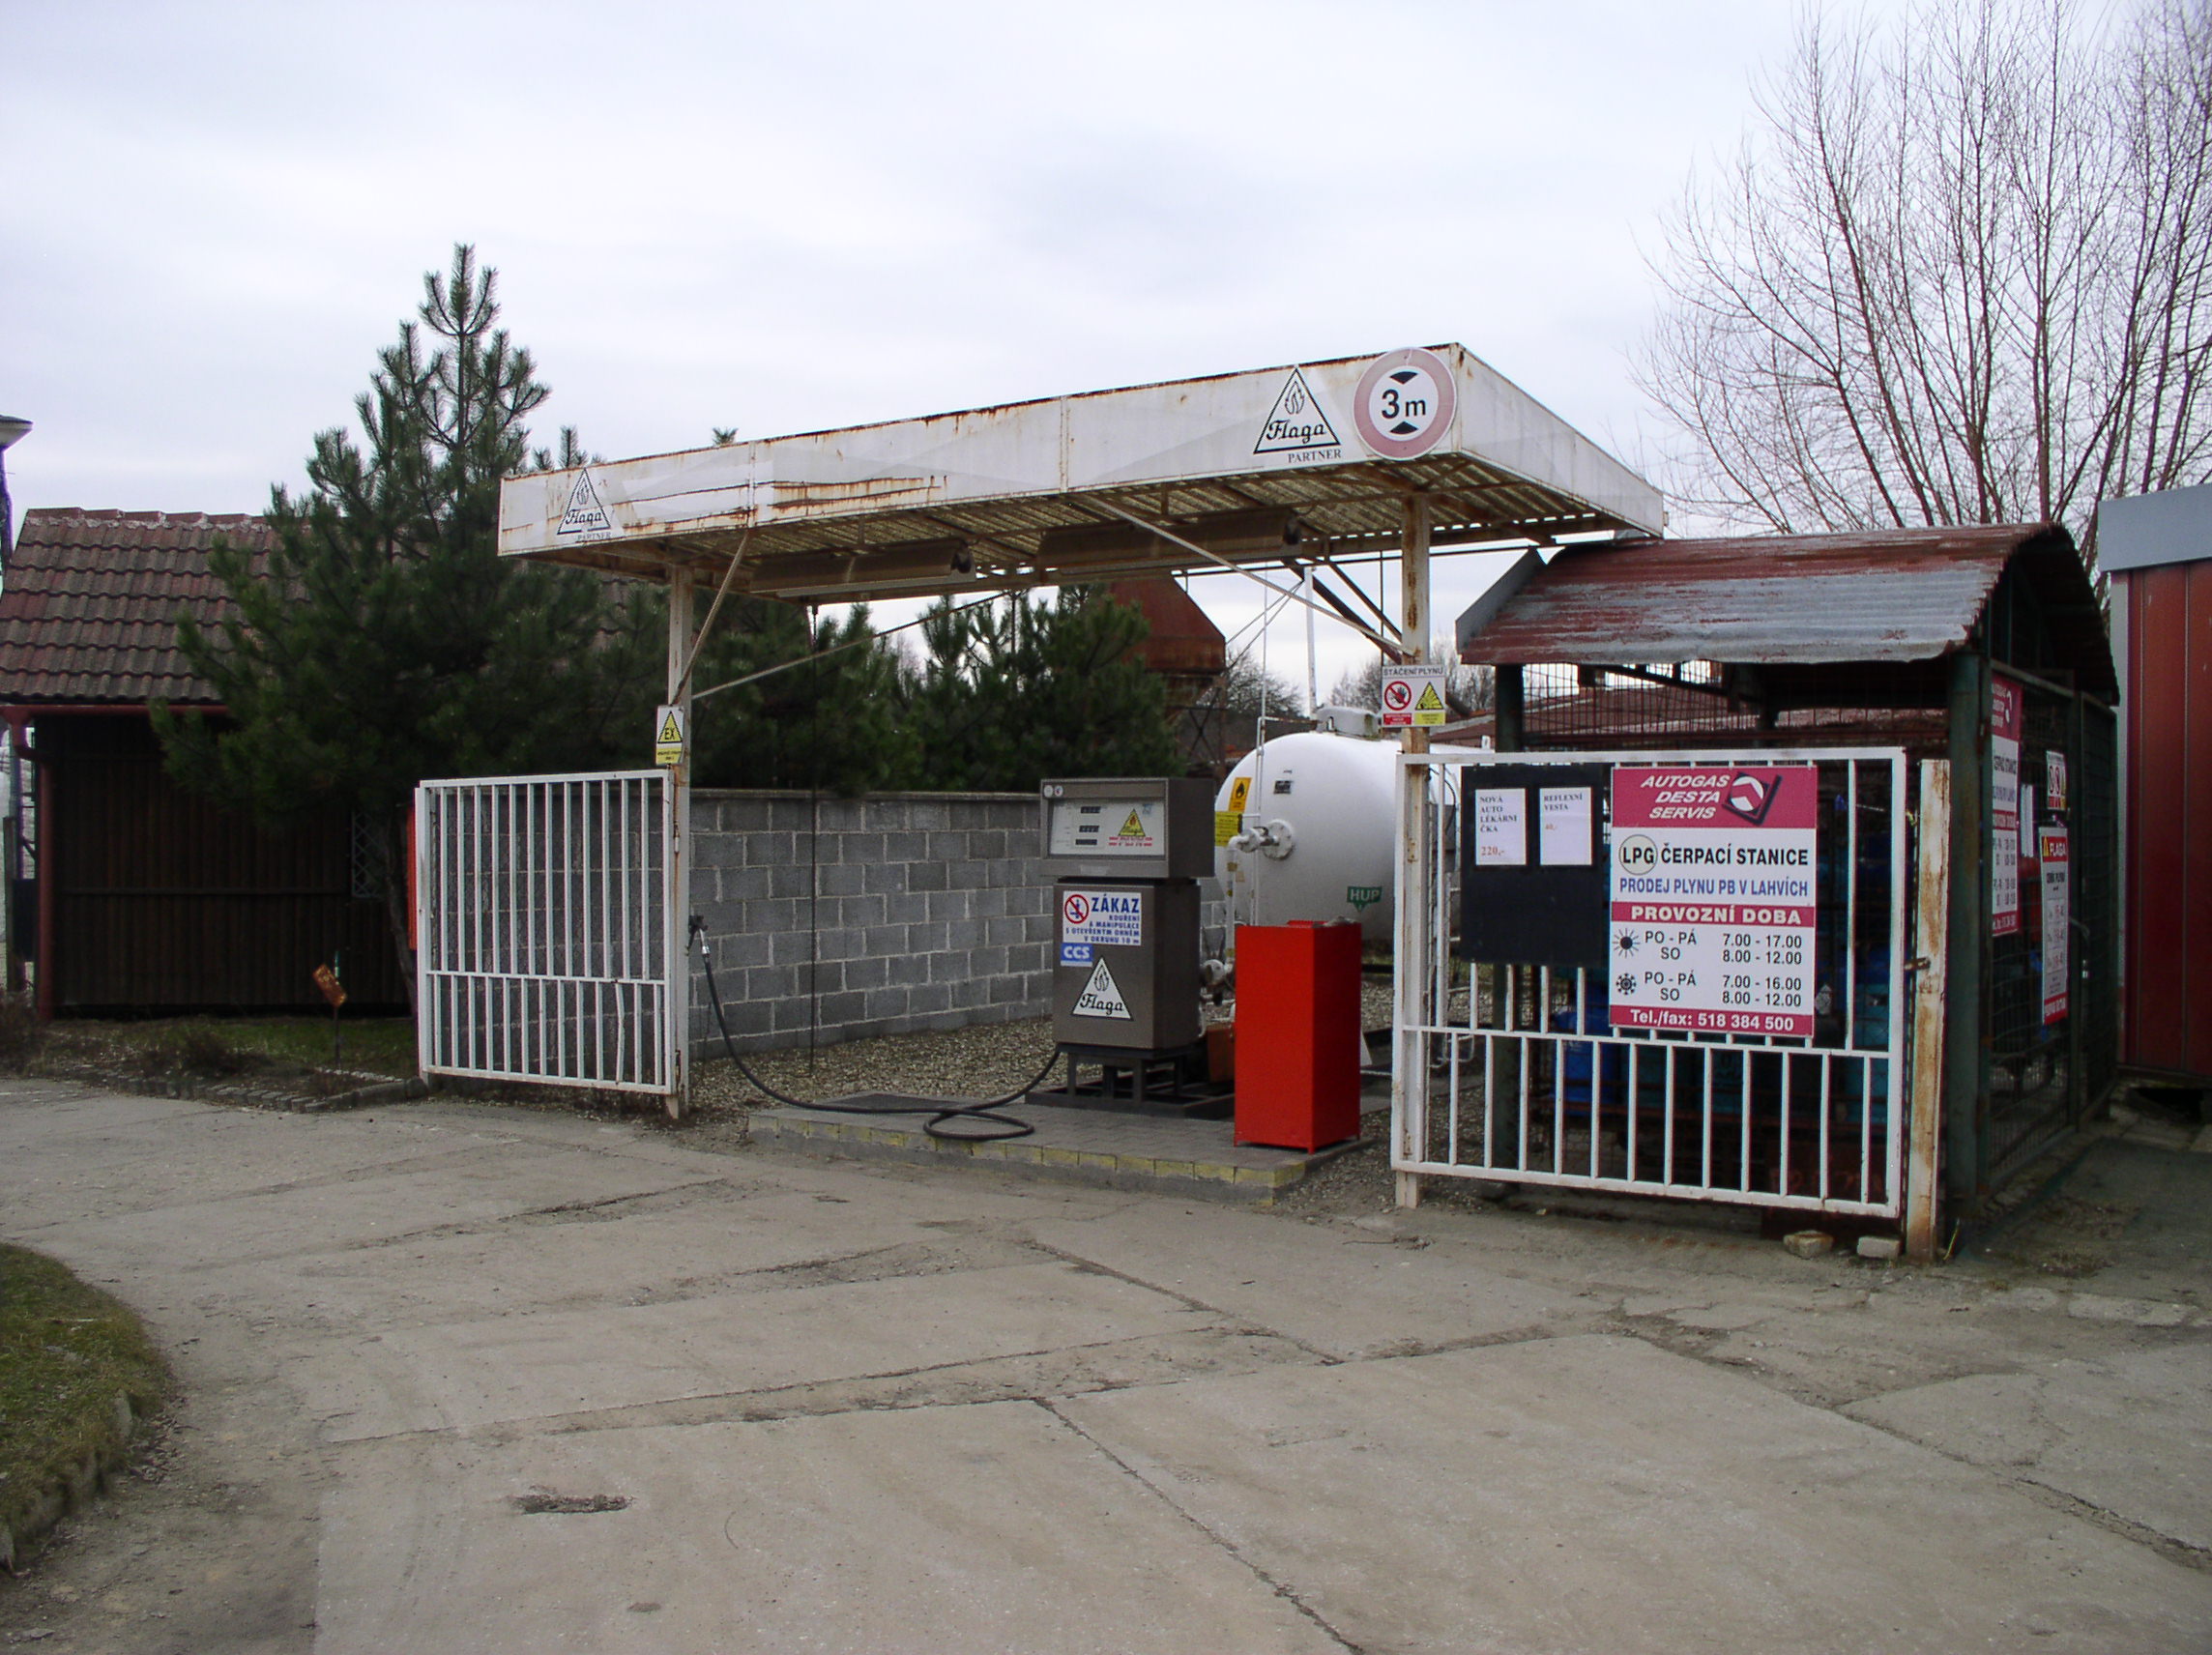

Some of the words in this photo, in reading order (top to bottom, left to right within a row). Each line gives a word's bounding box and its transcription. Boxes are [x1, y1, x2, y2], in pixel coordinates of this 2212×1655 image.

[1382, 389, 1400, 419] 3
[1406, 399, 1426, 418] m
[1266, 419, 1327, 444] Flaga
[1288, 449, 1342, 464] PARTNER
[565, 508, 601, 527] Flaga
[1418, 666, 1443, 675] PLYNU
[664, 727, 676, 740] EX
[1641, 774, 1731, 789] AUTOGAS
[1655, 791, 1721, 803] DESTA
[1649, 806, 1716, 820] SERVIS
[1622, 847, 1654, 864] LPG
[1661, 842, 1732, 864] ČERPACÍ
[1736, 848, 1808, 865] STANICE
[1350, 888, 1381, 901] HUP
[1620, 877, 1670, 893] PRODEJ
[1674, 878, 1714, 894] PLYNU
[1719, 879, 1735, 894] PB
[1739, 879, 1747, 895] V
[1751, 876, 1808, 896] LAHVÍCH
[1091, 893, 1140, 914] ZÁKAZ
[1631, 905, 1735, 923] PROVOZNÍ
[1742, 908, 1801, 924] DOBA
[1644, 931, 1665, 944] PO
[1678, 928, 1697, 945] PÁ
[1723, 933, 1751, 947] 7.00
[1765, 934, 1802, 948] 17.00
[1063, 945, 1091, 960] CCS
[1661, 947, 1680, 960] SO
[1723, 949, 1751, 963] 8.00
[1765, 951, 1801, 965] 12.00
[1644, 972, 1664, 984] PO
[1678, 970, 1697, 986] PÁ
[1723, 974, 1750, 989] 7.00
[1765, 976, 1801, 991] 16.00
[1080, 993, 1124, 1016] Flaga
[1660, 988, 1680, 1001] SO
[1723, 991, 1750, 1004] 8.00
[1765, 993, 1801, 1007] 12.00
[1630, 1009, 1693, 1027] Tel./fax:
[1698, 1013, 1727, 1029] 518
[1732, 1015, 1761, 1030] 384
[1764, 1017, 1794, 1031] 500
